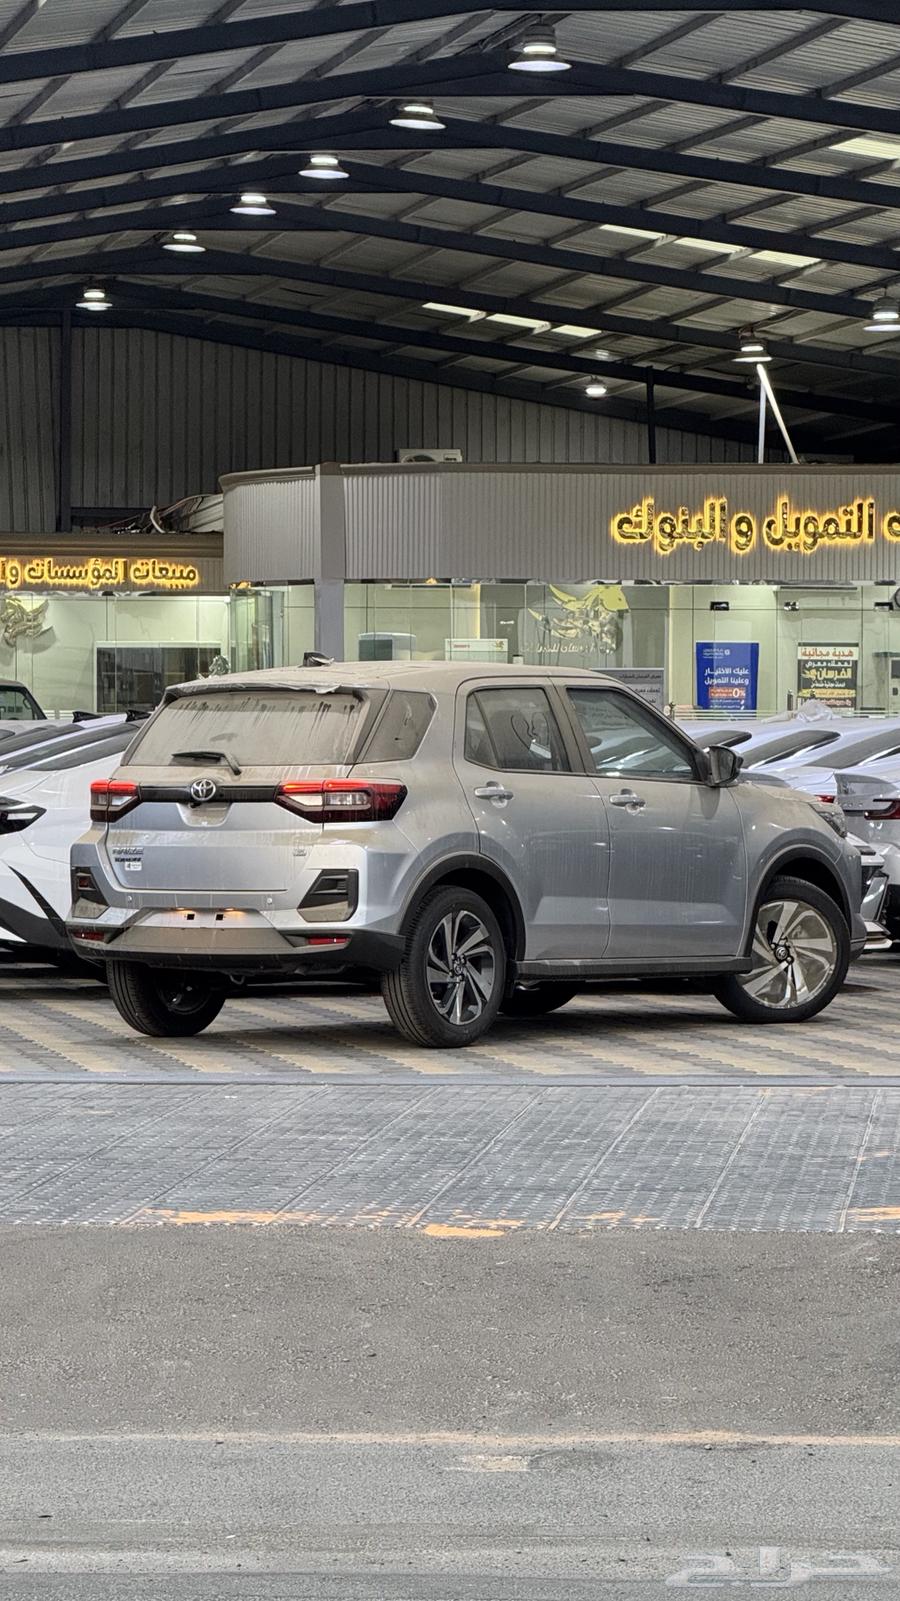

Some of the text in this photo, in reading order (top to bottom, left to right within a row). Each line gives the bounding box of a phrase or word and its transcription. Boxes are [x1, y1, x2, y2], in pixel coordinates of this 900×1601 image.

[763, 497, 876, 552] التمويل
[27, 558, 129, 586] المؤسسات
[132, 560, 198, 589] مبيعات
[832, 647, 854, 659] هدية
[733, 667, 750, 676] عليك
[817, 668, 852, 680] الفرسان
[704, 677, 749, 686] وعلينا التمويل
